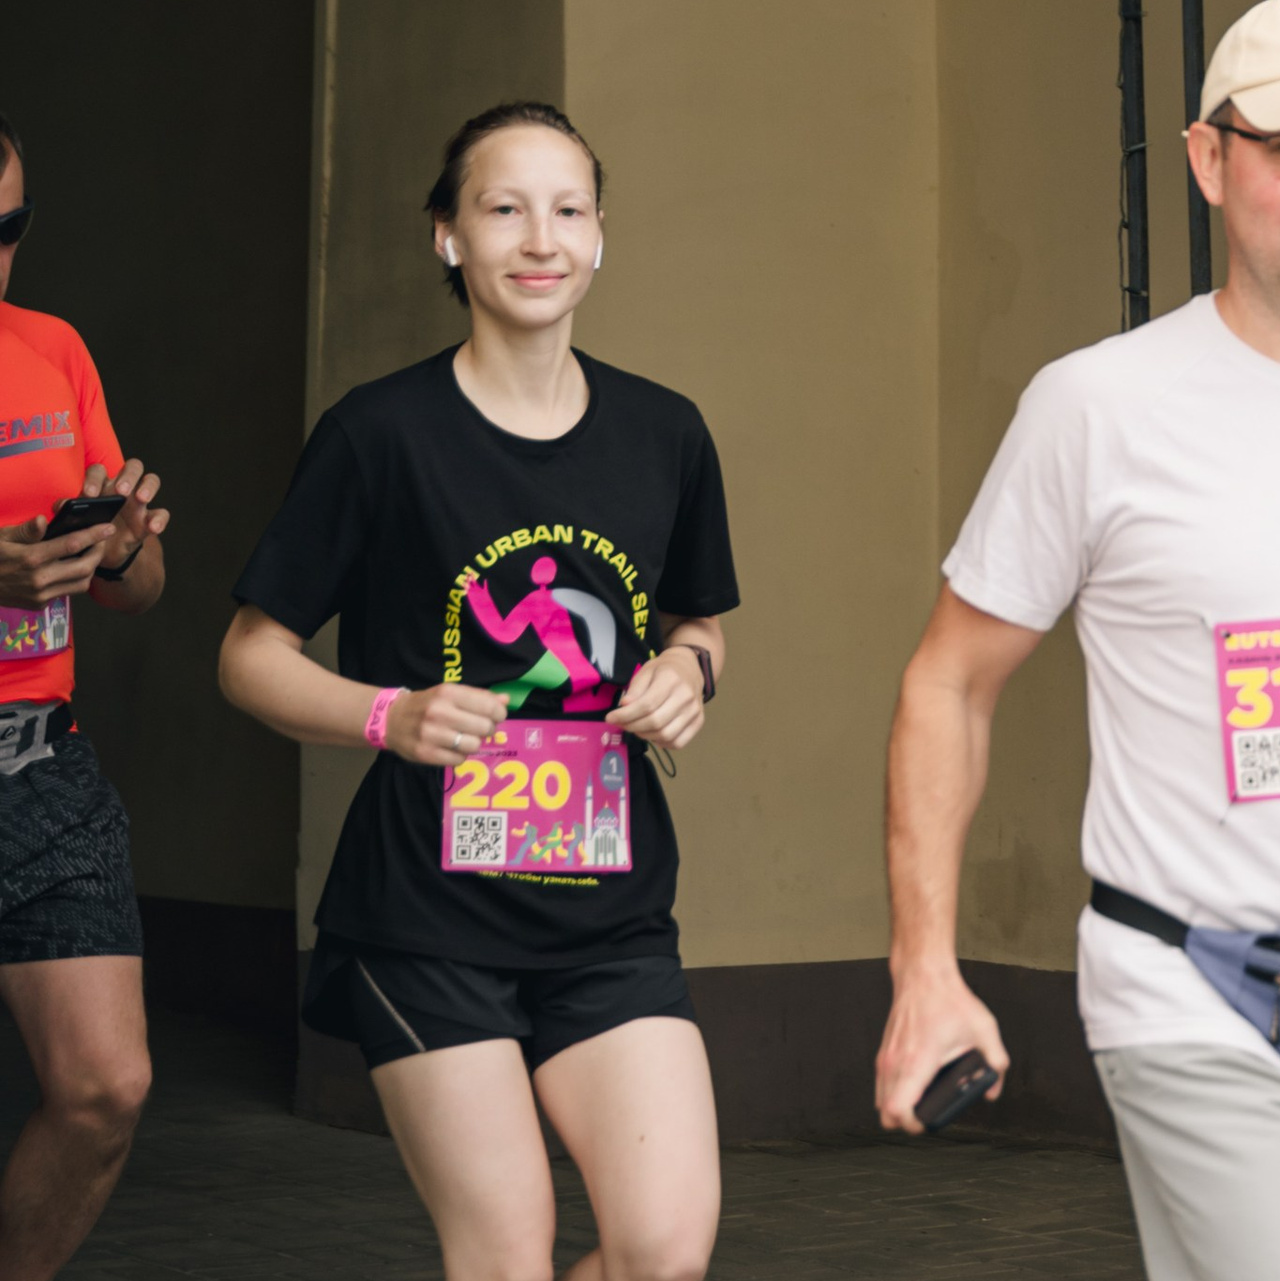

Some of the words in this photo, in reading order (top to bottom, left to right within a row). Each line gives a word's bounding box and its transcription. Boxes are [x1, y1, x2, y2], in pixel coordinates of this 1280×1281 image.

[443, 566, 480, 683] RUSSIAN
[475, 524, 573, 568] URBAN
[581, 529, 641, 593] TRAIL
[450, 760, 572, 811] 220
